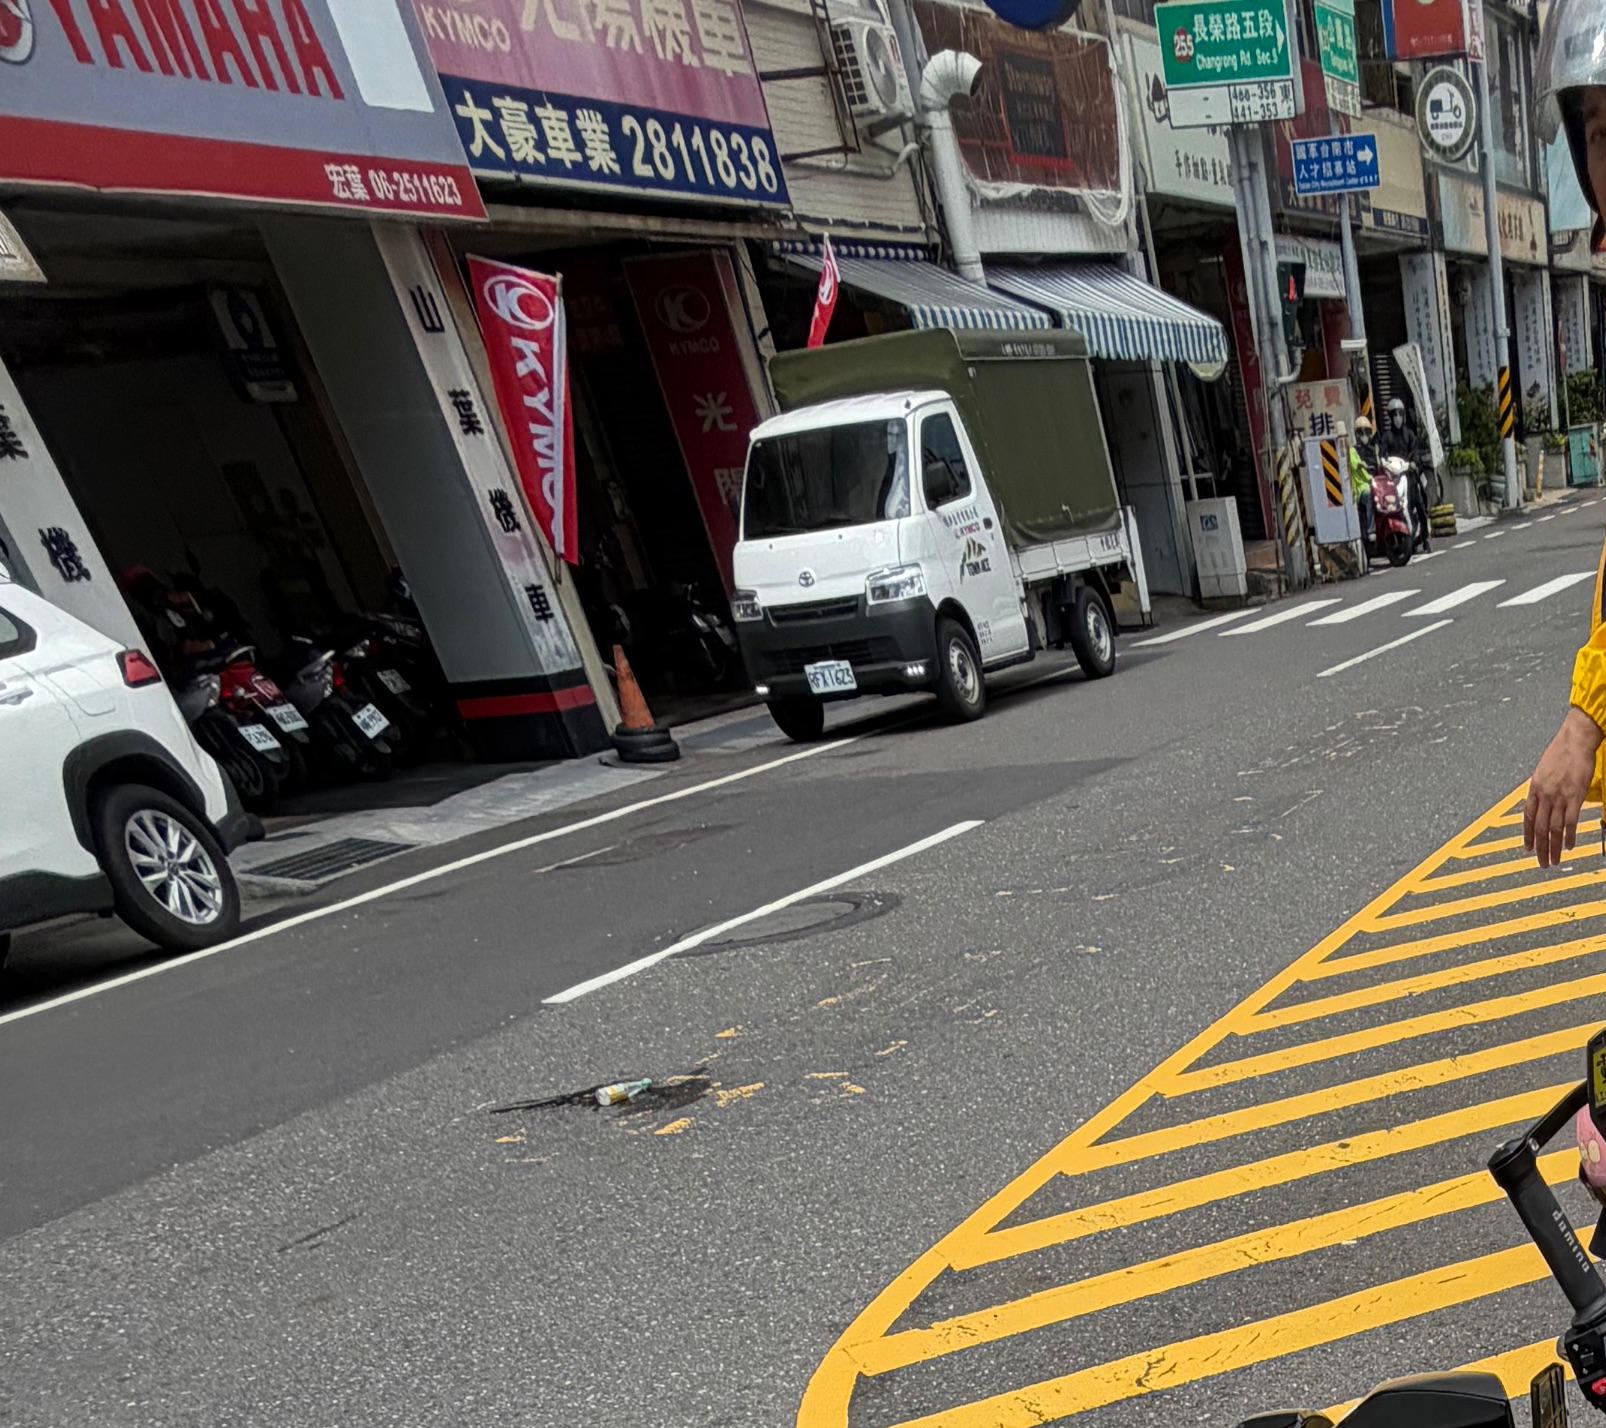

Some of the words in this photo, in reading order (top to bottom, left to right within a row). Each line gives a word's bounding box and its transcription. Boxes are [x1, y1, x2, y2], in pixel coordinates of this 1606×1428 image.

[422, 3, 512, 53] KYMCO
[1174, 34, 1194, 58] 255
[1193, 9, 1274, 43] 長榮路五段
[1196, 53, 1238, 72] Changrong
[456, 90, 621, 176] 大豪車業
[622, 115, 778, 194] 2811838
[323, 163, 370, 201] 宏葉
[368, 169, 462, 206] 06-2511623
[510, 336, 562, 537] KYMC
